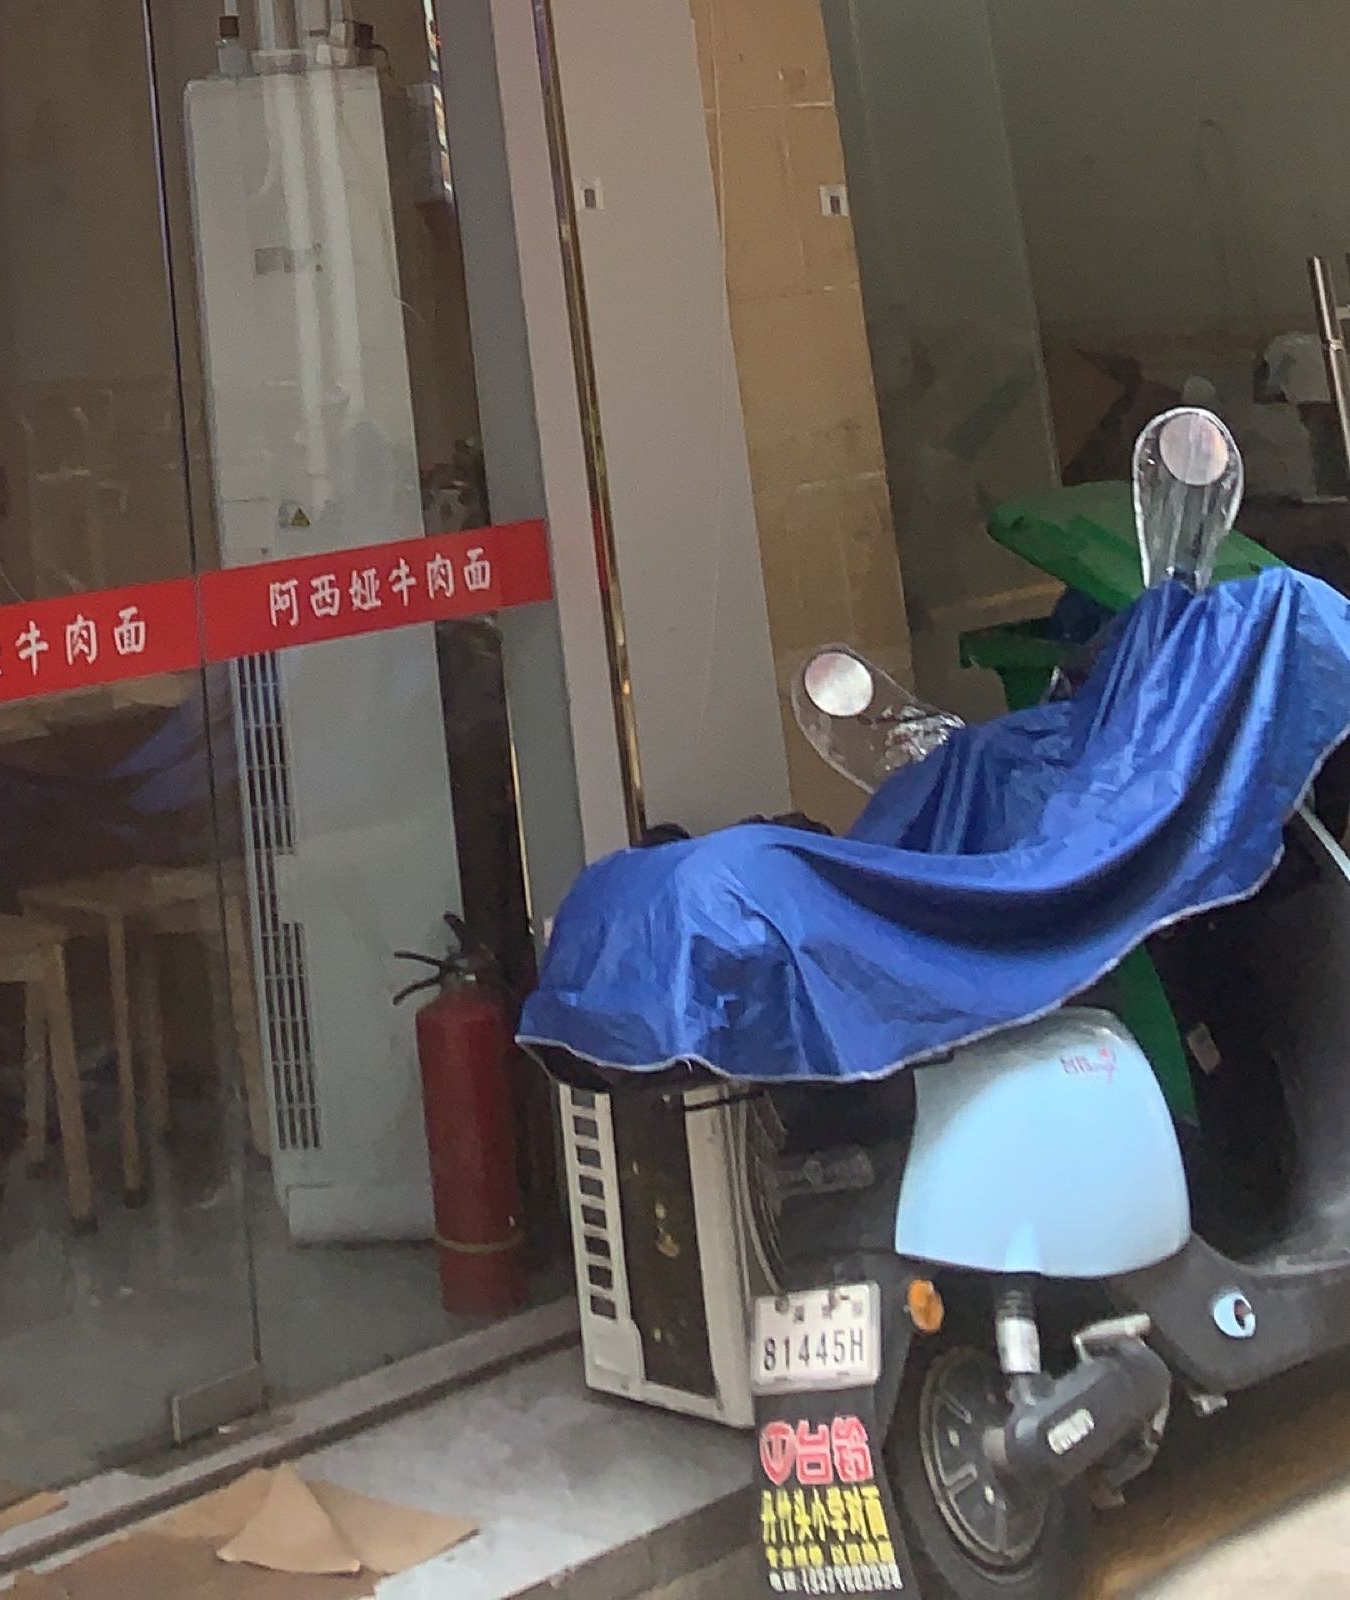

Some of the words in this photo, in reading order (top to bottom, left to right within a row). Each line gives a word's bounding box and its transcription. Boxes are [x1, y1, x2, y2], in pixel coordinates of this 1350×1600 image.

[267, 546, 495, 629] 阿西娅牛肉面
[763, 1327, 864, 1372] 81445H
